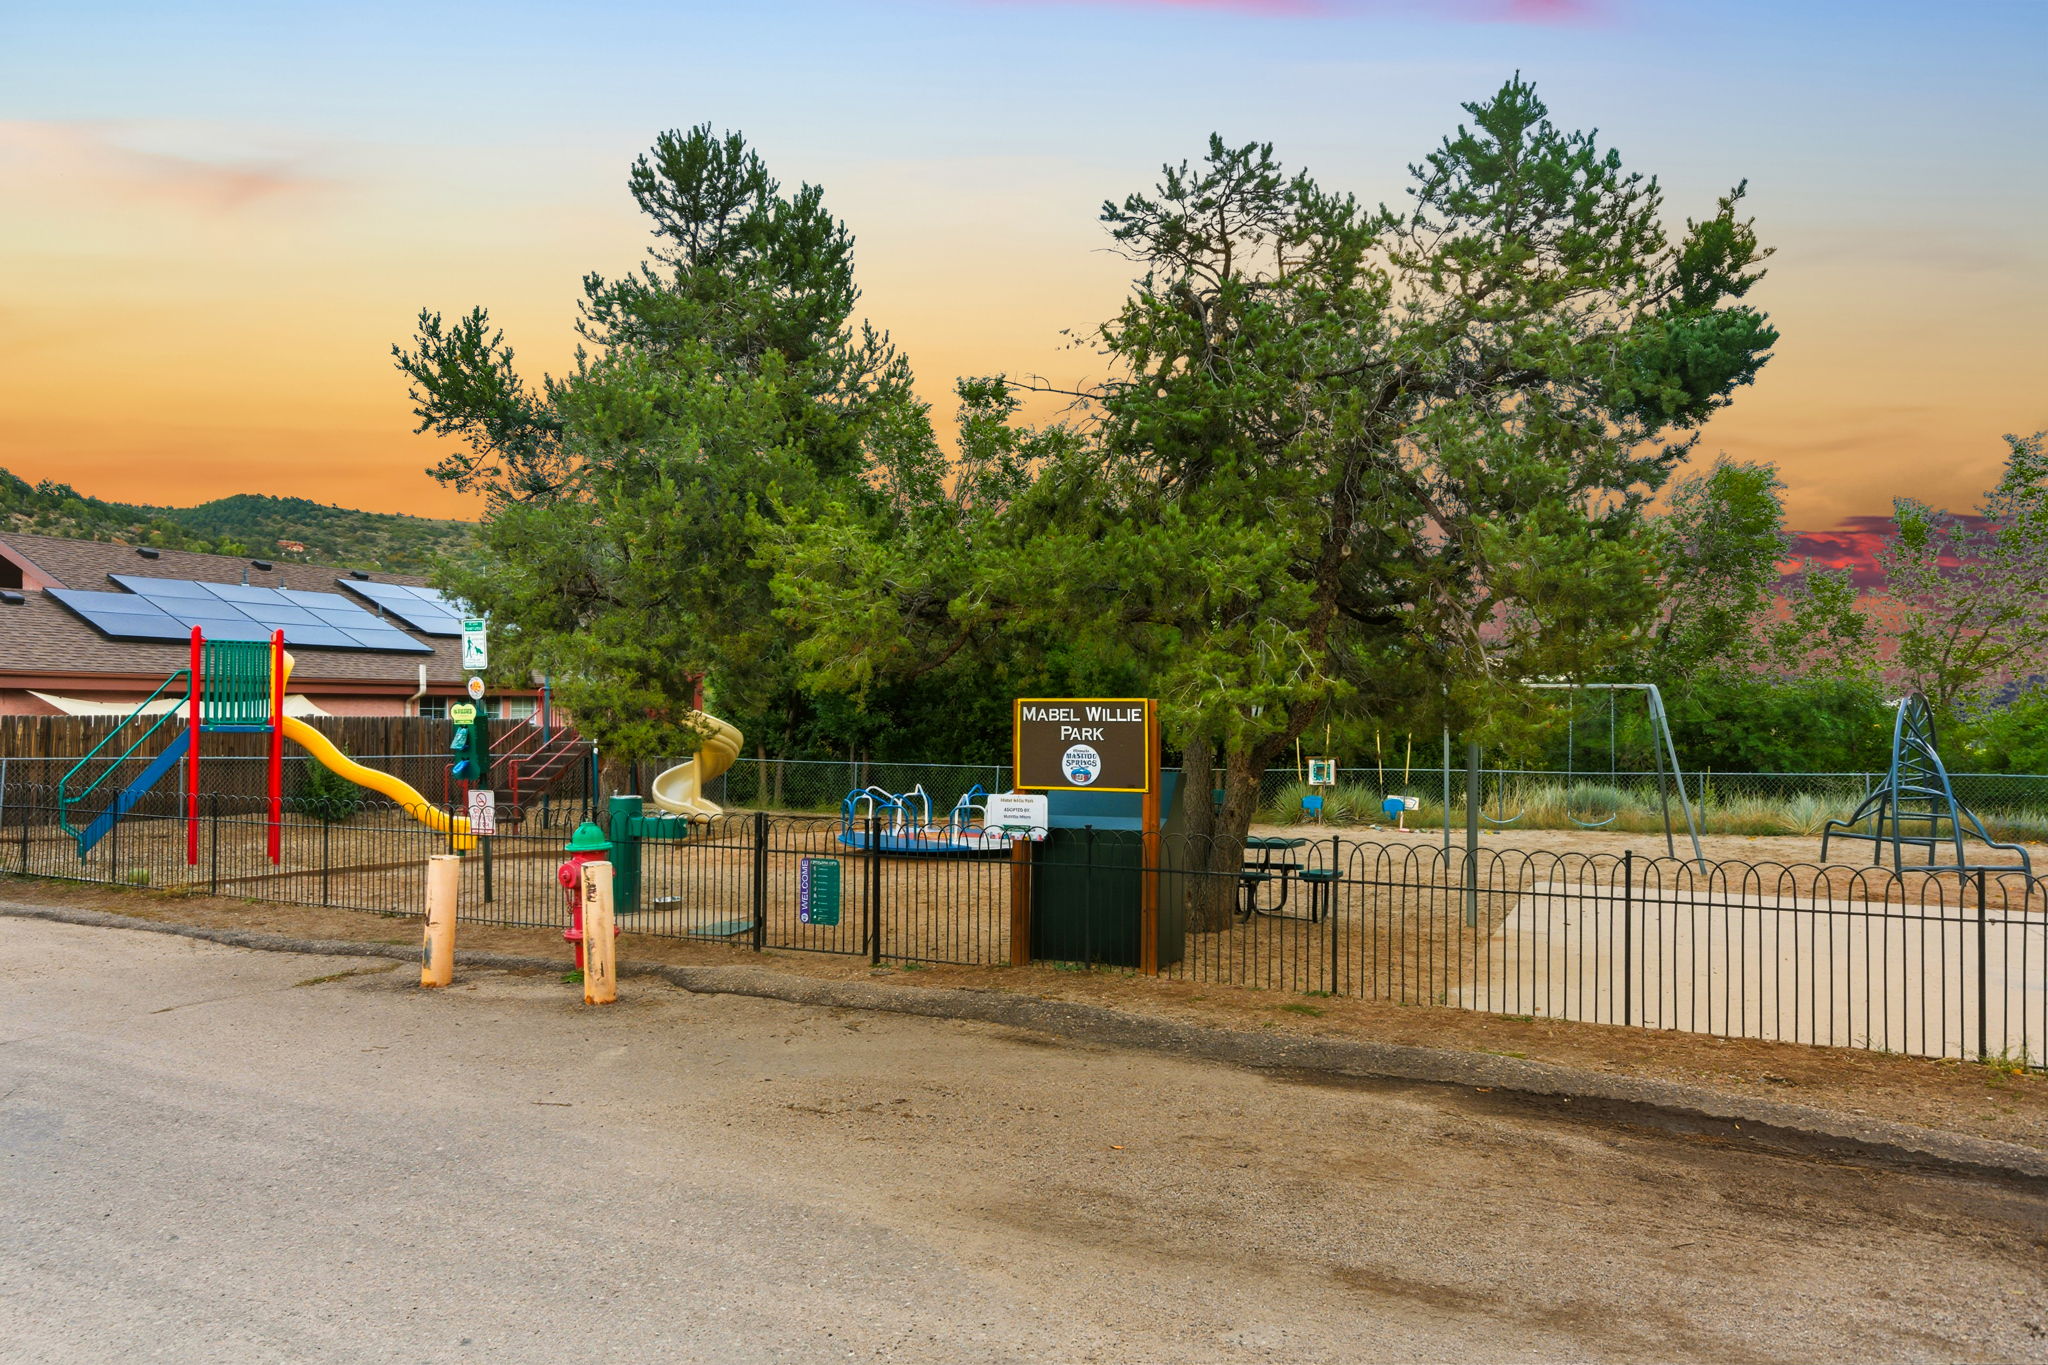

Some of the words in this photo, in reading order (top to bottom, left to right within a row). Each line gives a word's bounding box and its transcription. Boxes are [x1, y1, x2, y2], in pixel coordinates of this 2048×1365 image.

[1022, 706, 1081, 722] MABEL
[1085, 706, 1143, 722] WILLIE
[1060, 725, 1105, 741] PARK
[801, 860, 809, 910] WELCOME
